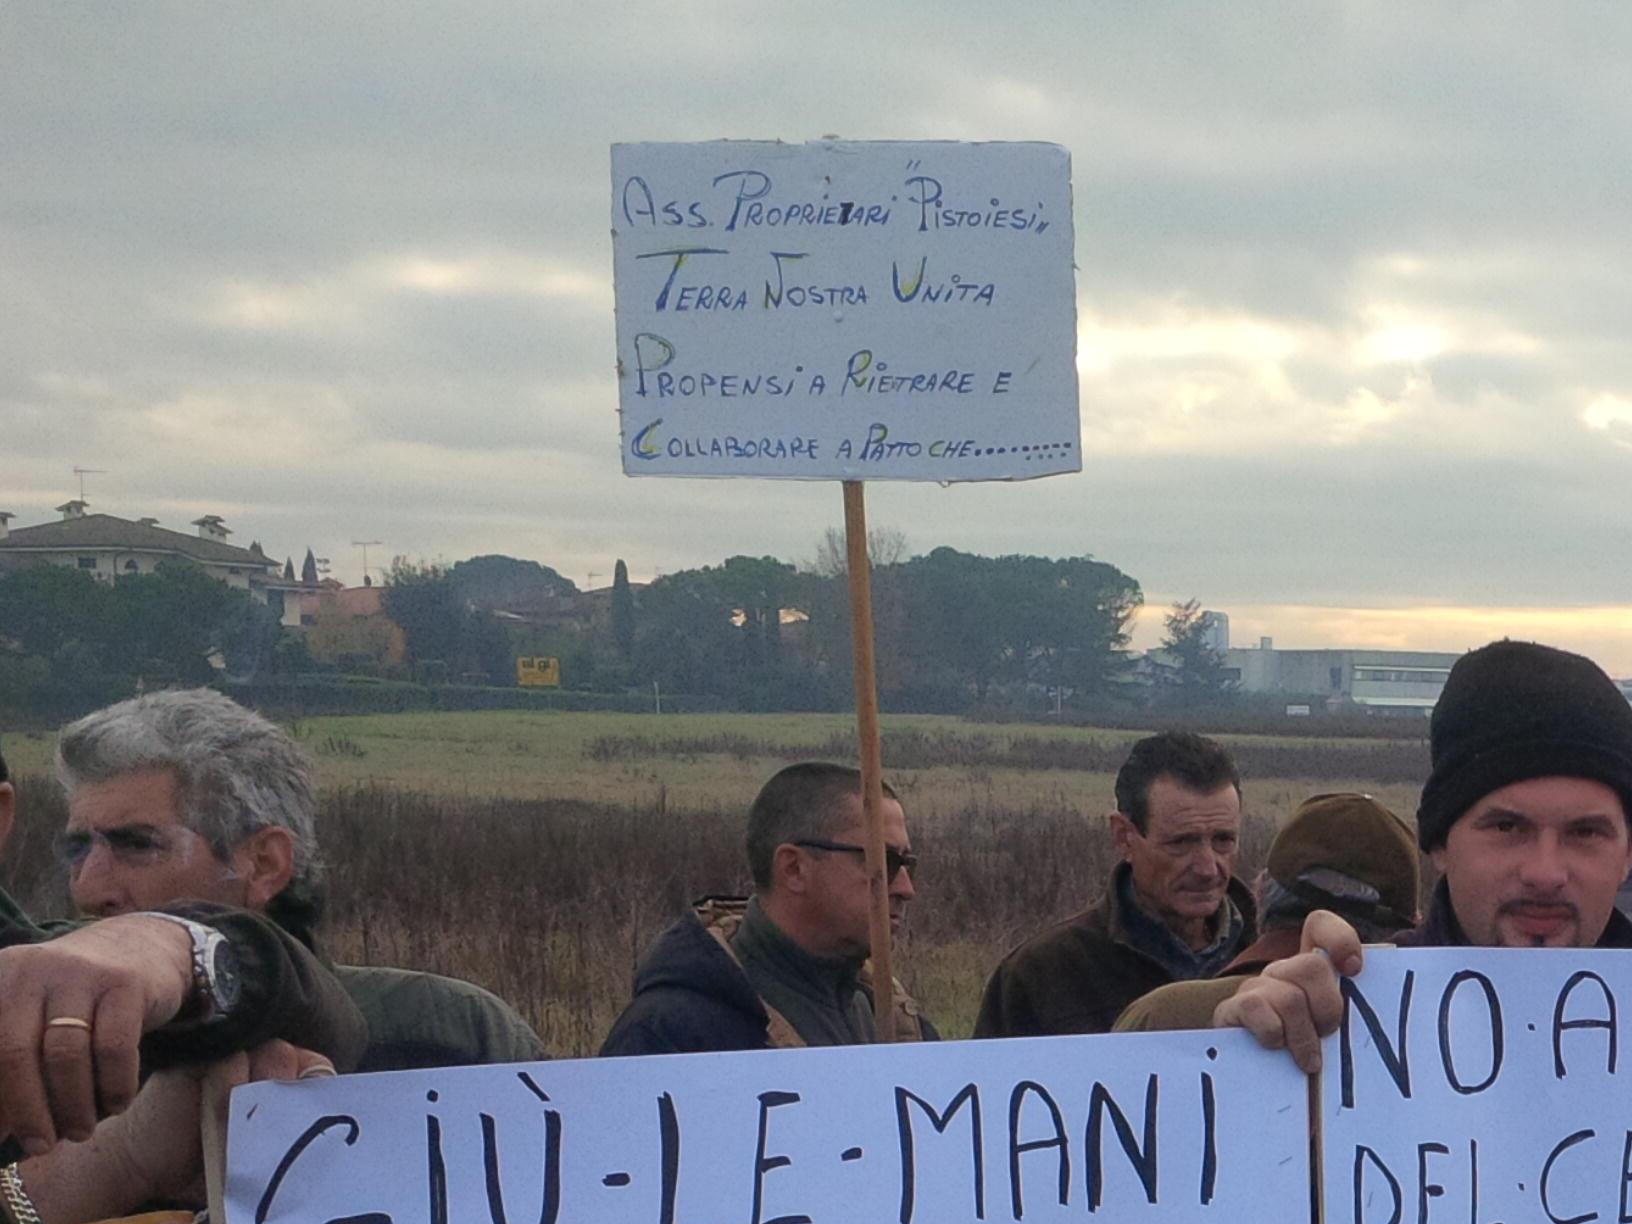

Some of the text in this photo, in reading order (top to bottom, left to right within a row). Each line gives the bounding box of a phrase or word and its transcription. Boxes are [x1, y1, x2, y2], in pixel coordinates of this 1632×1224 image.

[635, 248, 995, 312] TERRA NOSTRA UNITA
[634, 332, 803, 398] PROPENSI
[809, 374, 826, 396] A
[993, 371, 1012, 394] E
[631, 418, 819, 460] COLLABORARE
[835, 439, 852, 460] A
